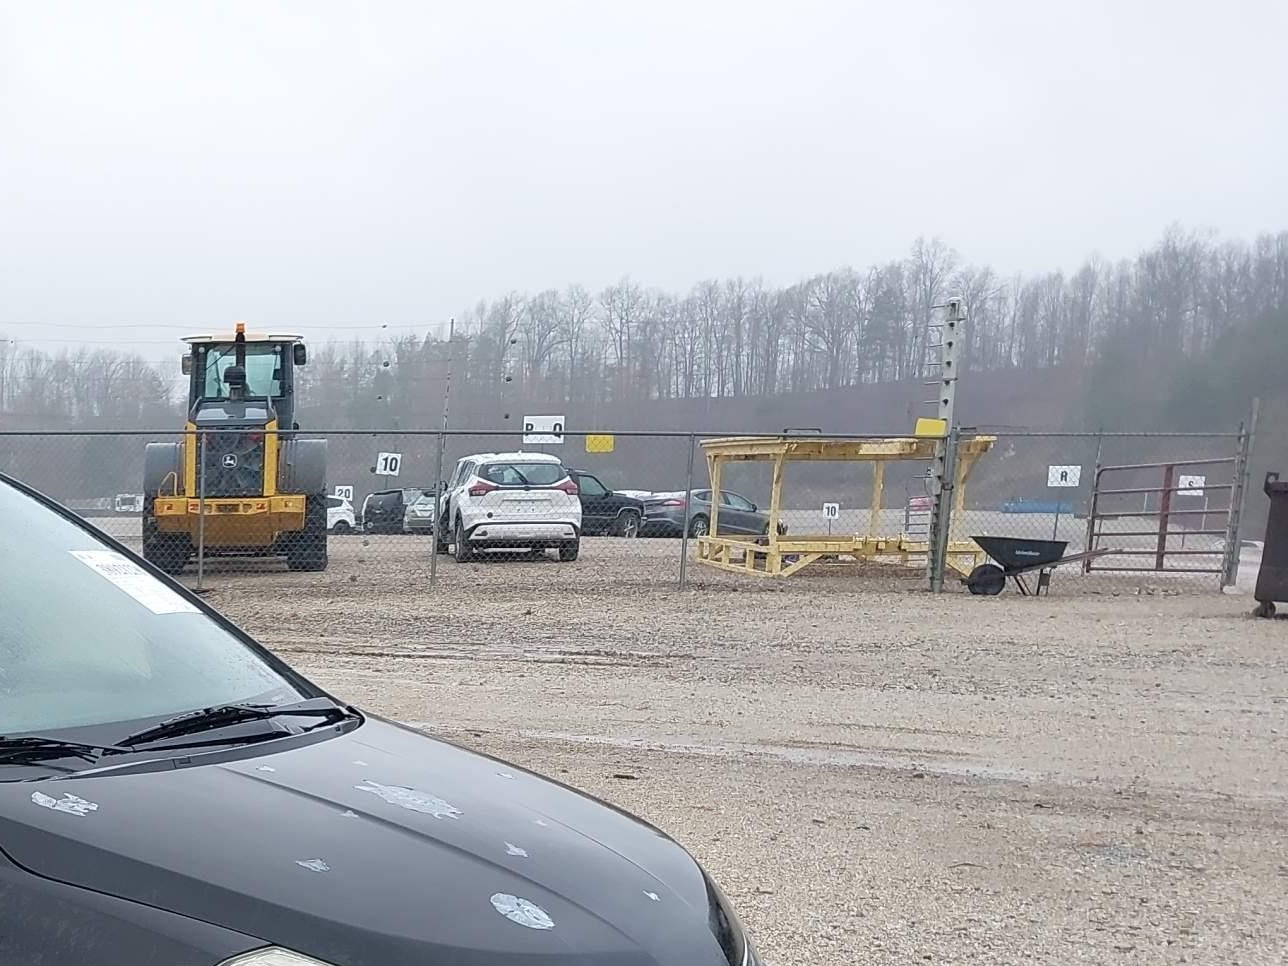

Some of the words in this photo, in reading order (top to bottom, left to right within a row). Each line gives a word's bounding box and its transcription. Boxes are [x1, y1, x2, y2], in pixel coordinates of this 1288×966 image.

[382, 456, 399, 472] 10
[338, 488, 351, 498] 20
[825, 505, 837, 517] 10
